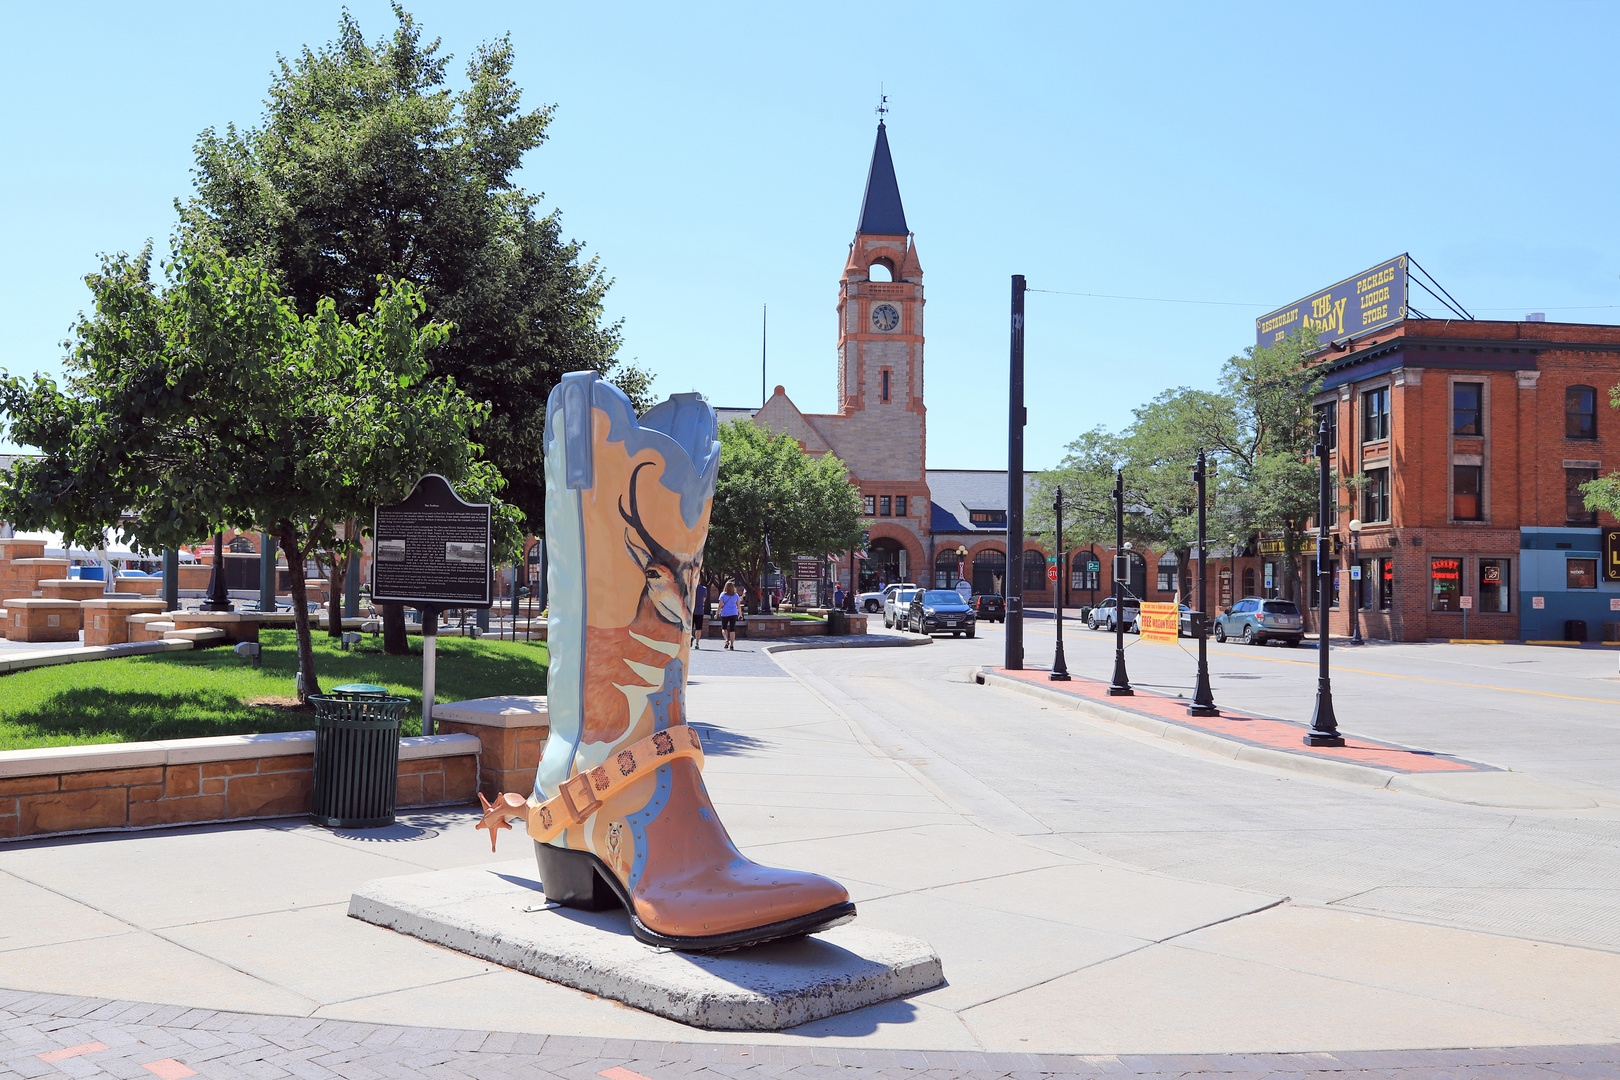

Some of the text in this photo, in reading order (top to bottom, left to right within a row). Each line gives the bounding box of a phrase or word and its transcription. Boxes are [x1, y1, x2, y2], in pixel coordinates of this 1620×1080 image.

[1357, 267, 1395, 294] PACKAGE
[1311, 293, 1332, 319] THE
[1360, 286, 1390, 309] LIQUOR
[1261, 308, 1299, 334] RESTAURANT
[1362, 304, 1388, 326] STORE
[1275, 330, 1285, 342] AND
[1141, 615, 1177, 630] FREE WAGON RIDES
